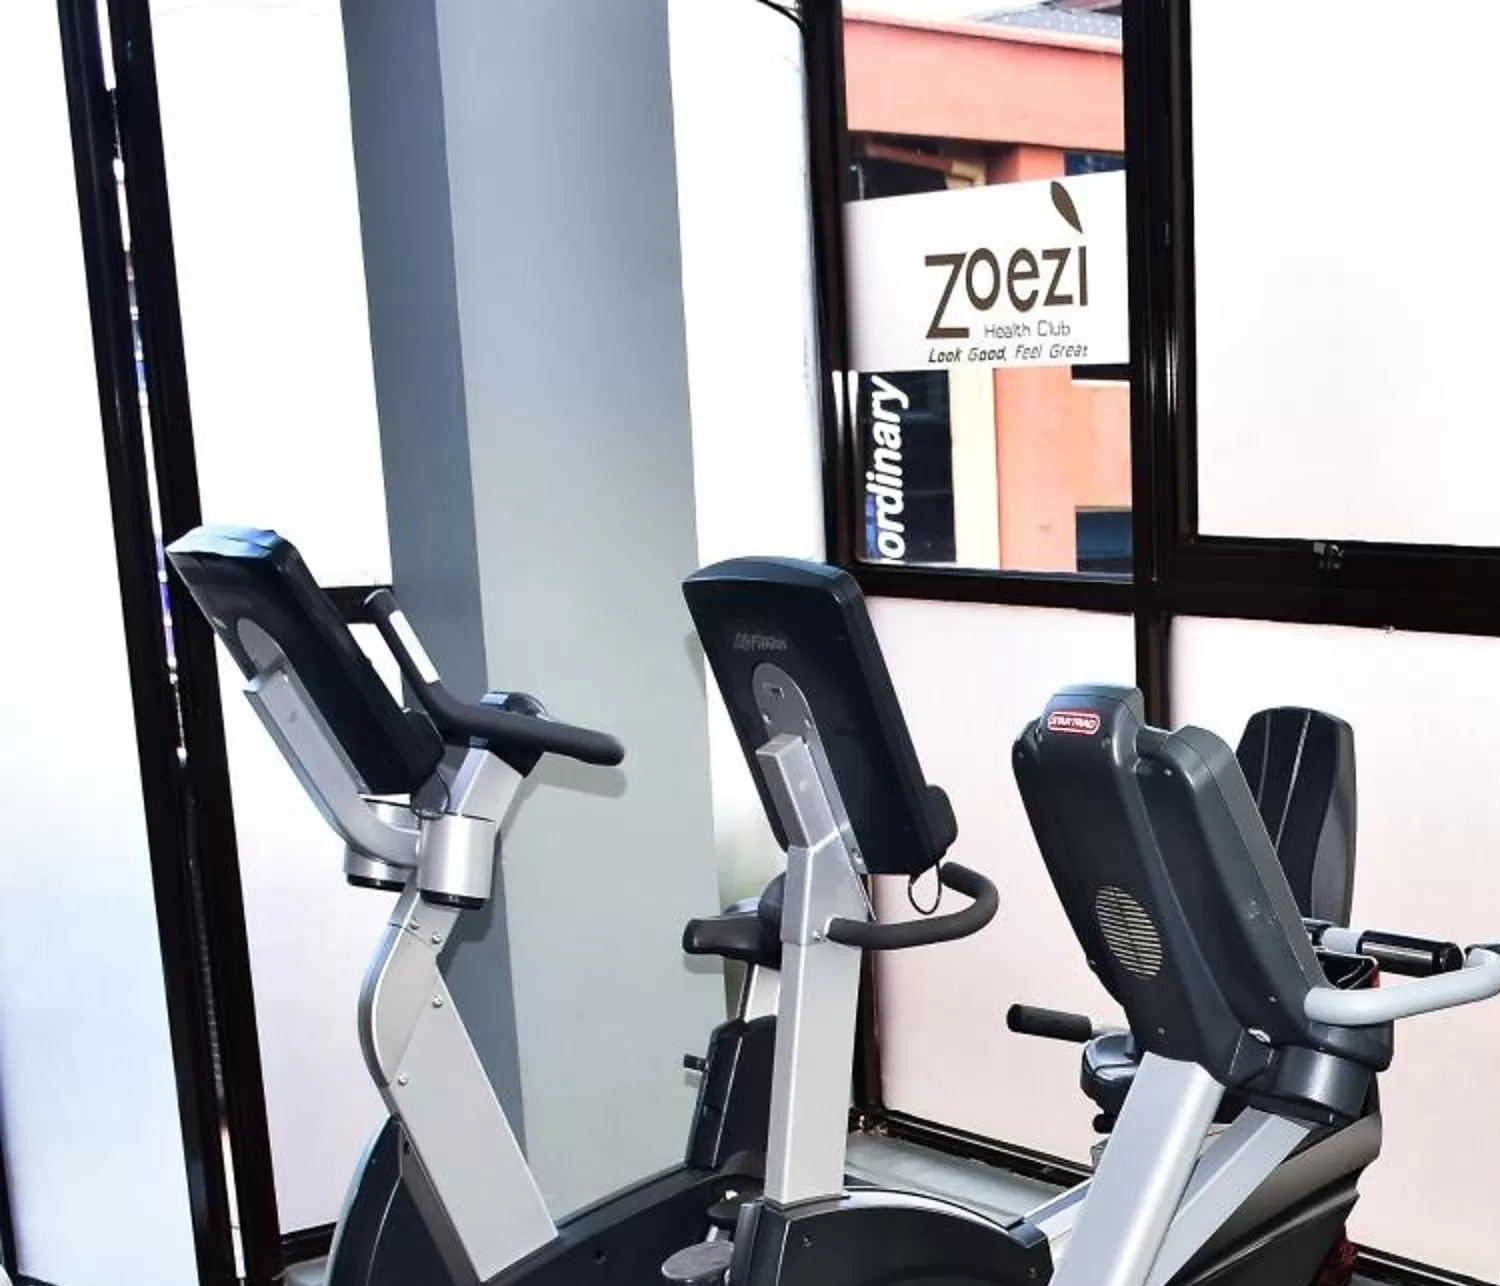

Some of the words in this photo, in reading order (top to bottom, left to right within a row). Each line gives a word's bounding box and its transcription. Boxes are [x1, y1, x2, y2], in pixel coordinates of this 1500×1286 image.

[984, 321, 1031, 339] Health
[1037, 319, 1071, 337] Club
[928, 347, 963, 363] Look
[1014, 344, 1043, 360] Feel
[1049, 343, 1089, 358] Great
[865, 374, 910, 565] ordinary
